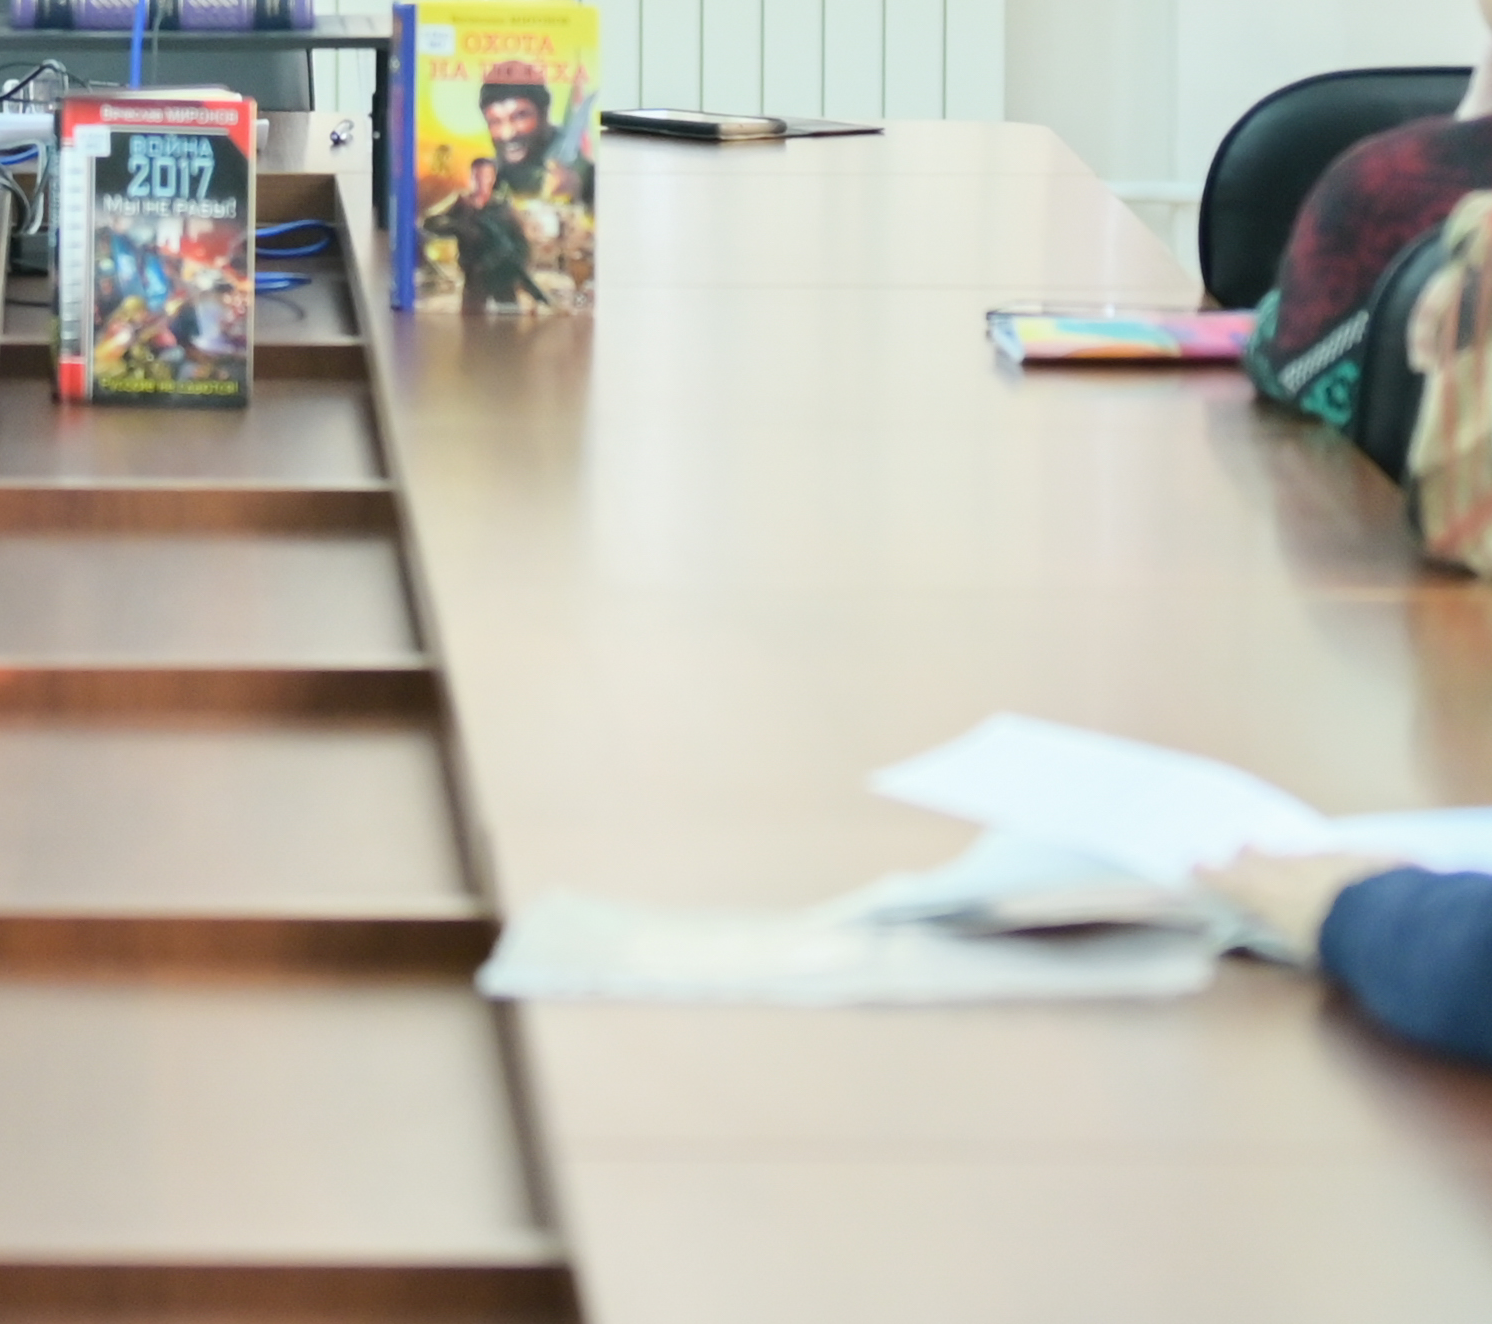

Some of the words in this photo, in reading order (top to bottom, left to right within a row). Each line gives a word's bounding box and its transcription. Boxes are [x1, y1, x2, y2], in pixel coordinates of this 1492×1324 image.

[463, 32, 555, 55] ОХОТА
[429, 59, 468, 80] НА
[165, 106, 238, 125] МИРОНОВ
[129, 134, 214, 158] ВОЙНА
[127, 154, 215, 201] 2017
